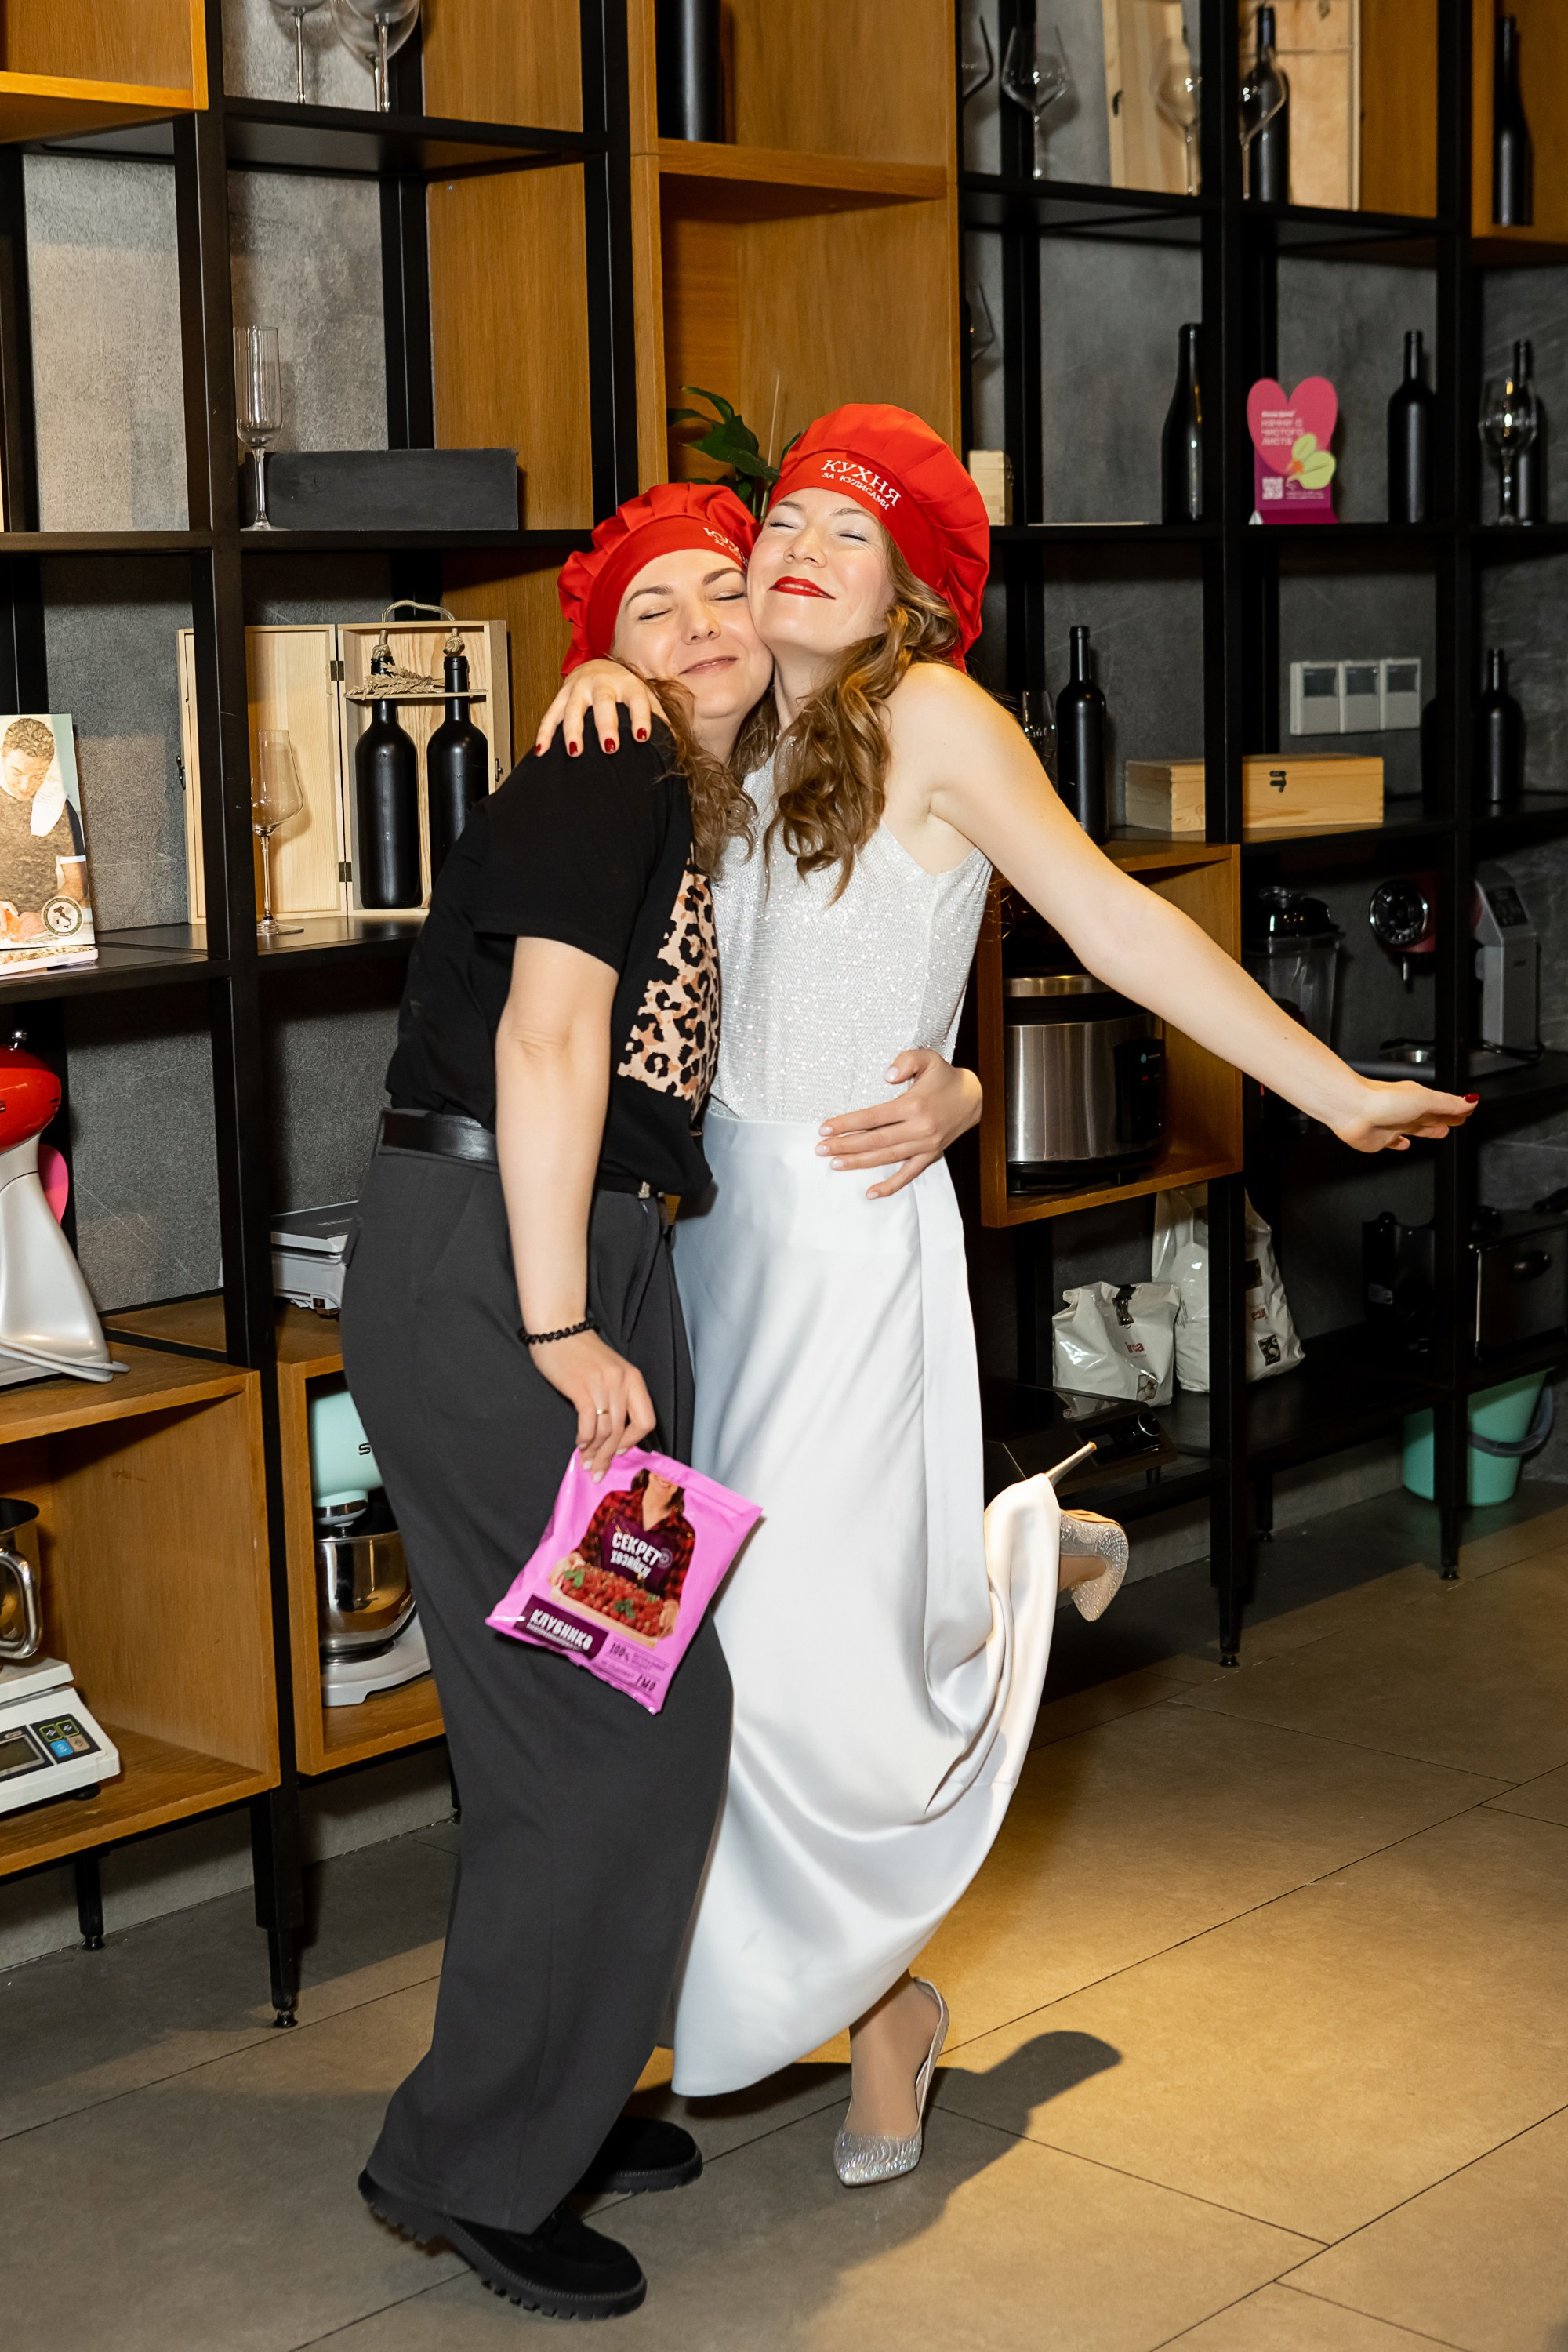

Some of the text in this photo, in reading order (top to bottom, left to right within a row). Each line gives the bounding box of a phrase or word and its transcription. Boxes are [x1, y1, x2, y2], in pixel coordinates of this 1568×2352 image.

[821, 459, 901, 507] КУХНЯ
[839, 475, 890, 510] КУЛИСАМИ
[612, 1531, 662, 1566] СЕКРЕТ
